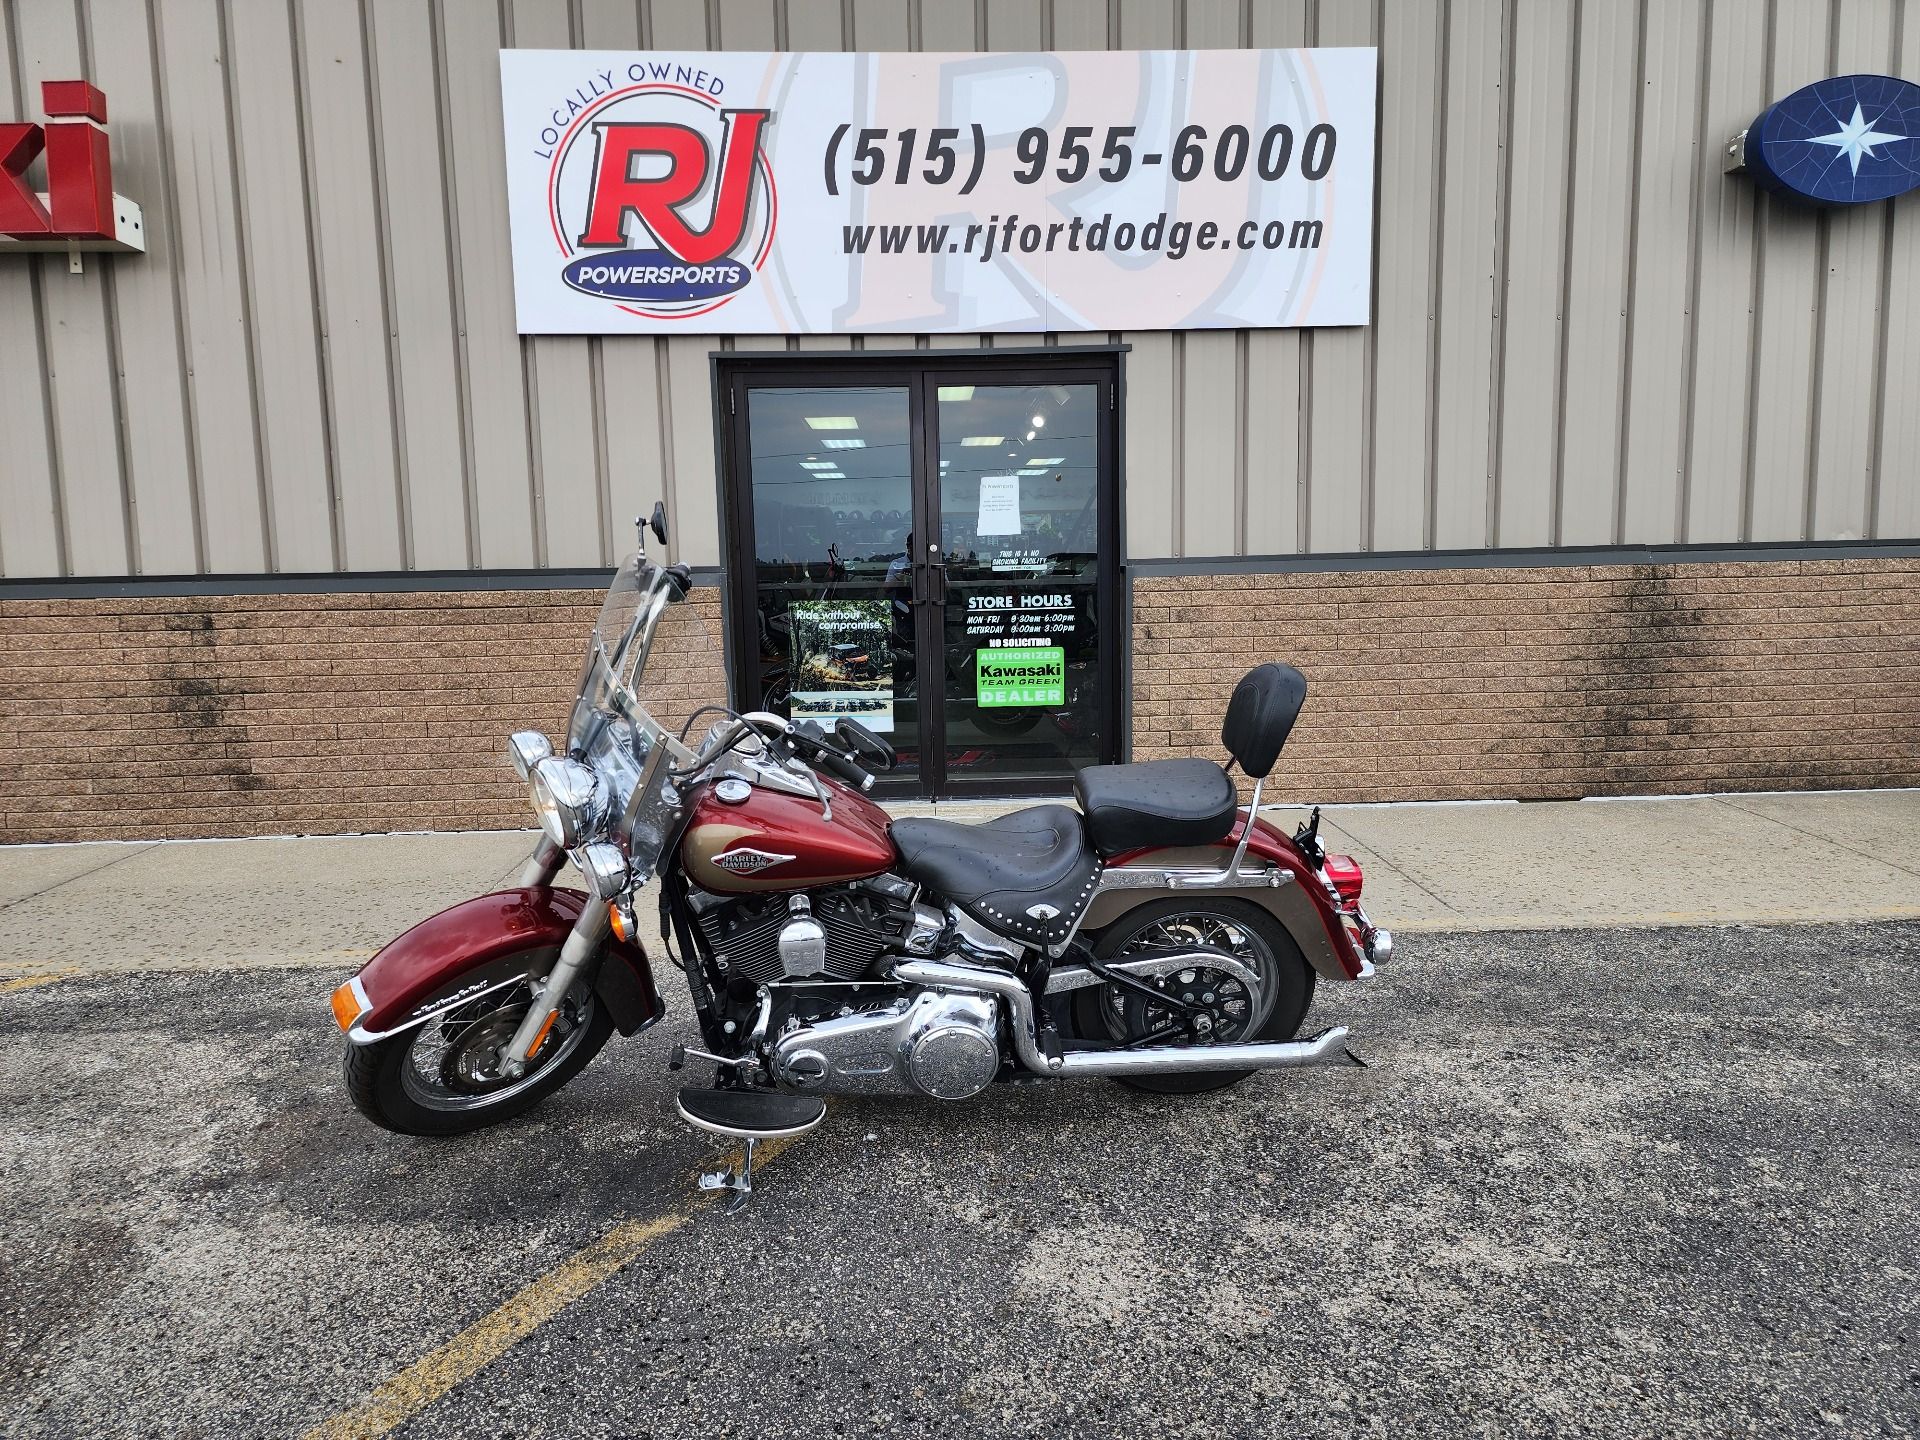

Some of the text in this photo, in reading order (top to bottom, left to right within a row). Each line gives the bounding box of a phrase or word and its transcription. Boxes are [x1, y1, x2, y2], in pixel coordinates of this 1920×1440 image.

[534, 62, 724, 160] LOCALLY OWNED
[823, 122, 1338, 196] (515) 955-6000
[577, 108, 771, 265] RJ
[842, 212, 1324, 264] www.rjfortdodge.com
[578, 266, 741, 284] POWERSPORTS
[1031, 549, 1040, 557] NO
[968, 594, 1073, 609] STORE HOURS
[796, 609, 861, 620] Ride without
[819, 621, 883, 632] compromise.
[966, 625, 1005, 635] SATURDAY
[989, 637, 1052, 648] NO SOLICITING
[980, 651, 1060, 661] AUTHORIZED
[980, 662, 1061, 678] Kawasaki
[980, 689, 1060, 703] DEALER
